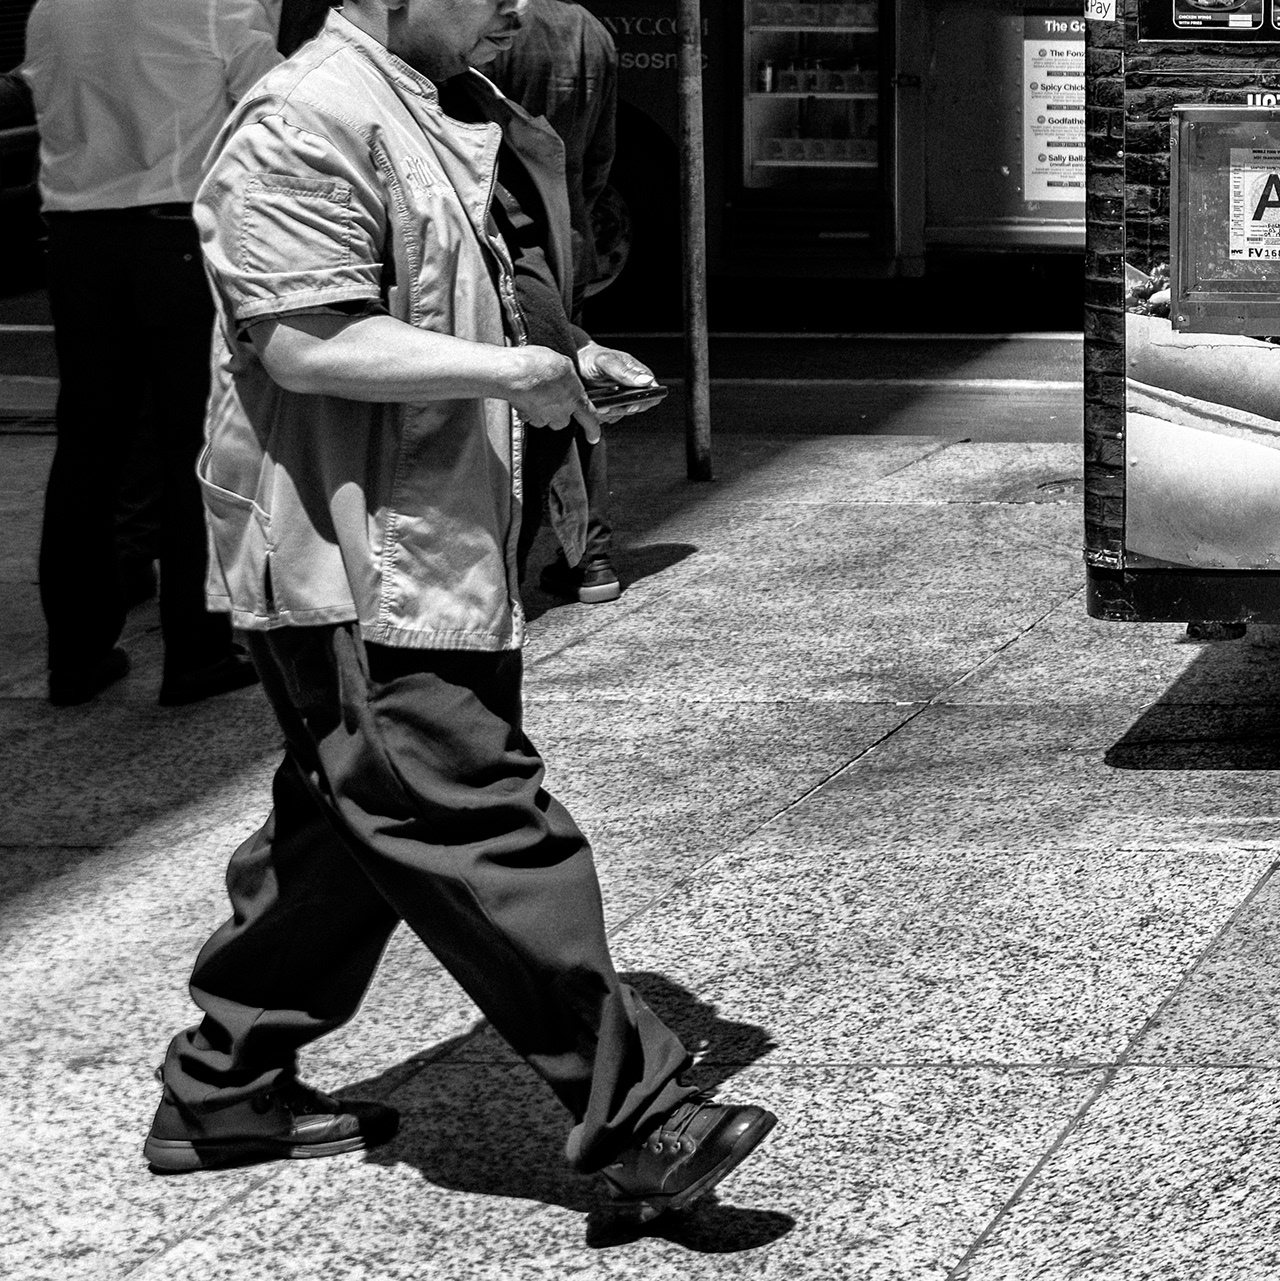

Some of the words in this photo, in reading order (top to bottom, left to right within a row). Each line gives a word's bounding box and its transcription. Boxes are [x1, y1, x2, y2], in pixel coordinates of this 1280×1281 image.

[1044, 20, 1068, 32] The
[1050, 49, 1065, 57] The
[1040, 83, 1062, 92] Spicy
[1048, 154, 1067, 163] Sally
